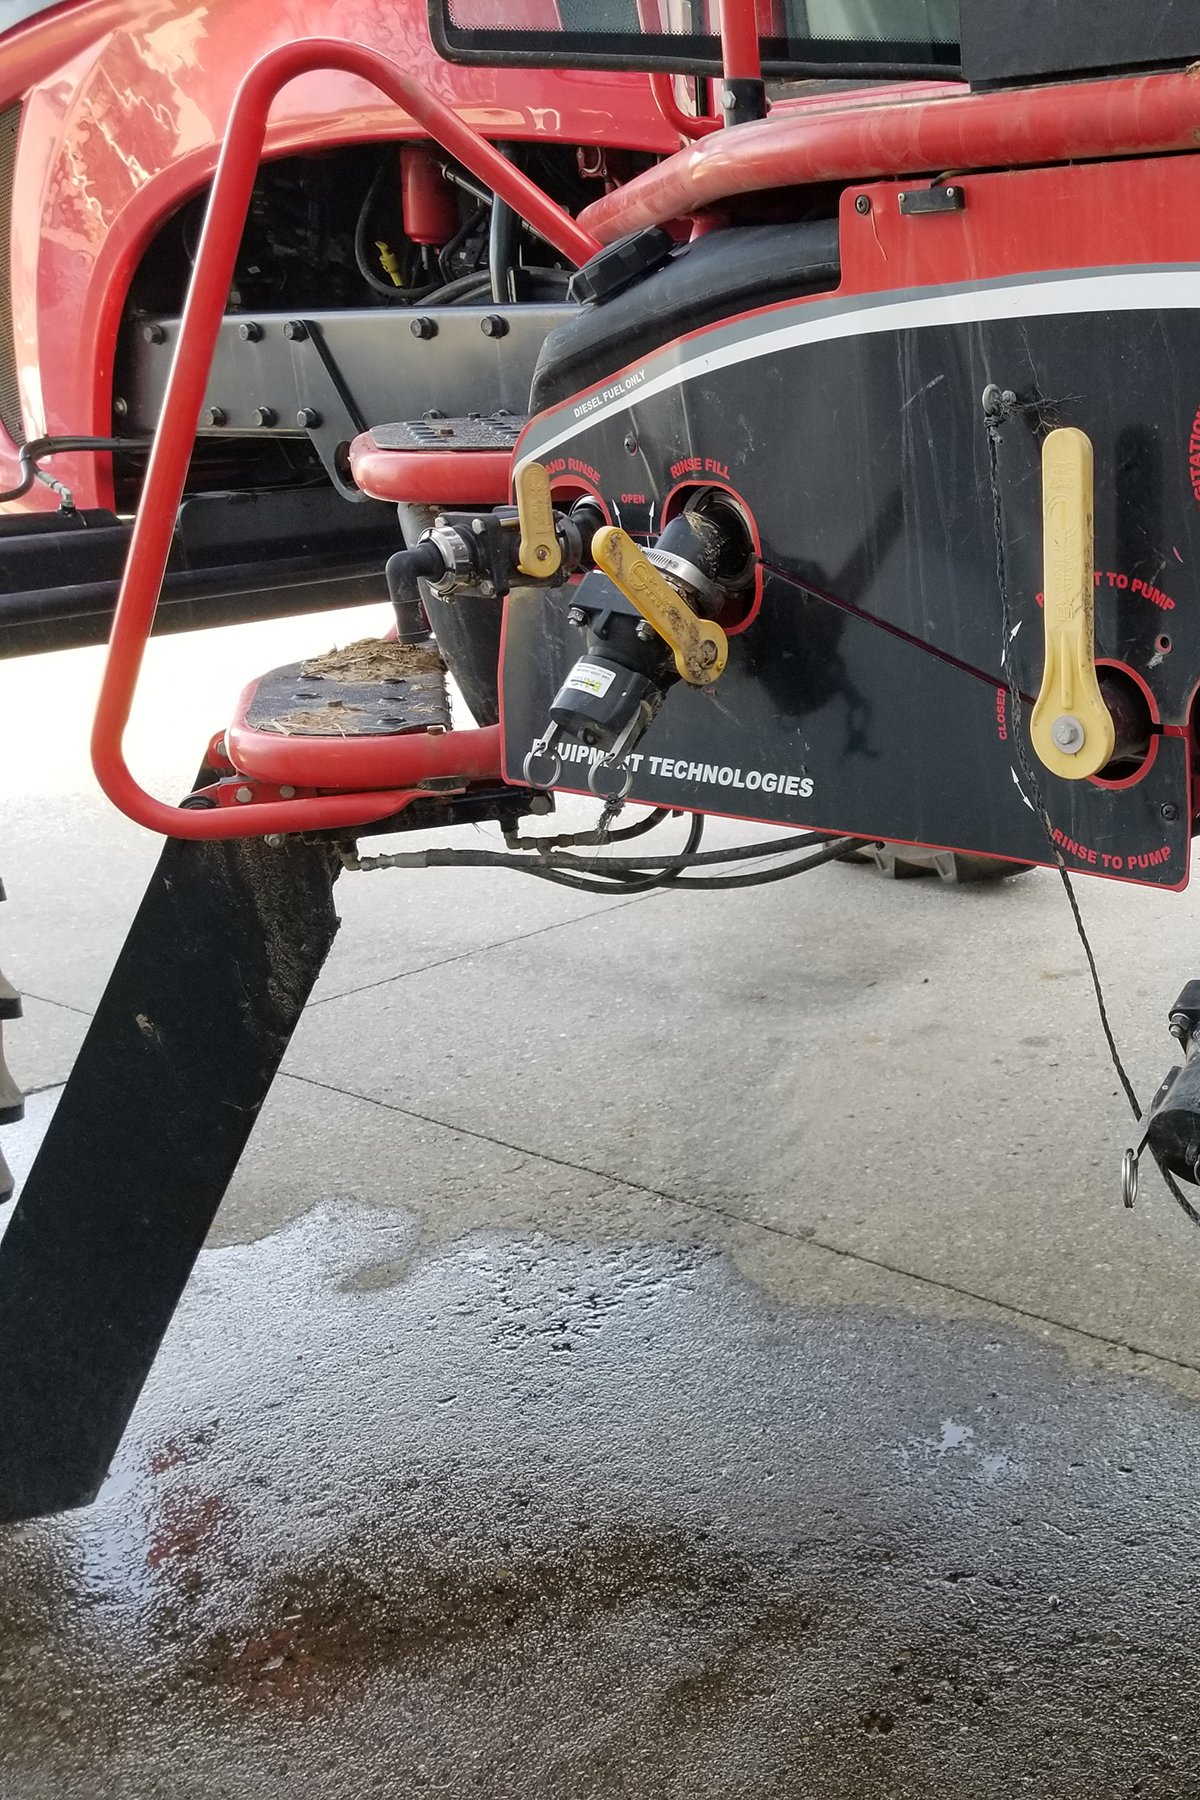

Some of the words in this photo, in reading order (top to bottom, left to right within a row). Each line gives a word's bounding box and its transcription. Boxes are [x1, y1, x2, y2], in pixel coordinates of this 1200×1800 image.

[573, 397, 603, 418] DIESEL
[602, 384, 625, 402] FUEL
[624, 369, 647, 389] ONLY
[545, 457, 566, 475] AND
[567, 457, 601, 484] RINSE
[670, 457, 702, 479] RINSE
[704, 458, 731, 480] FILL
[621, 494, 645, 505] OPEN
[1106, 572, 1128, 589] TO
[1131, 578, 1176, 611] PUMP
[996, 687, 1008, 740] CLOSED
[532, 738, 645, 773] EUIPMNT
[649, 756, 815, 798] TECHNOLOGIES
[1051, 827, 1098, 865] RINSE
[1101, 853, 1124, 870] TO
[1127, 845, 1172, 870] PUMP
